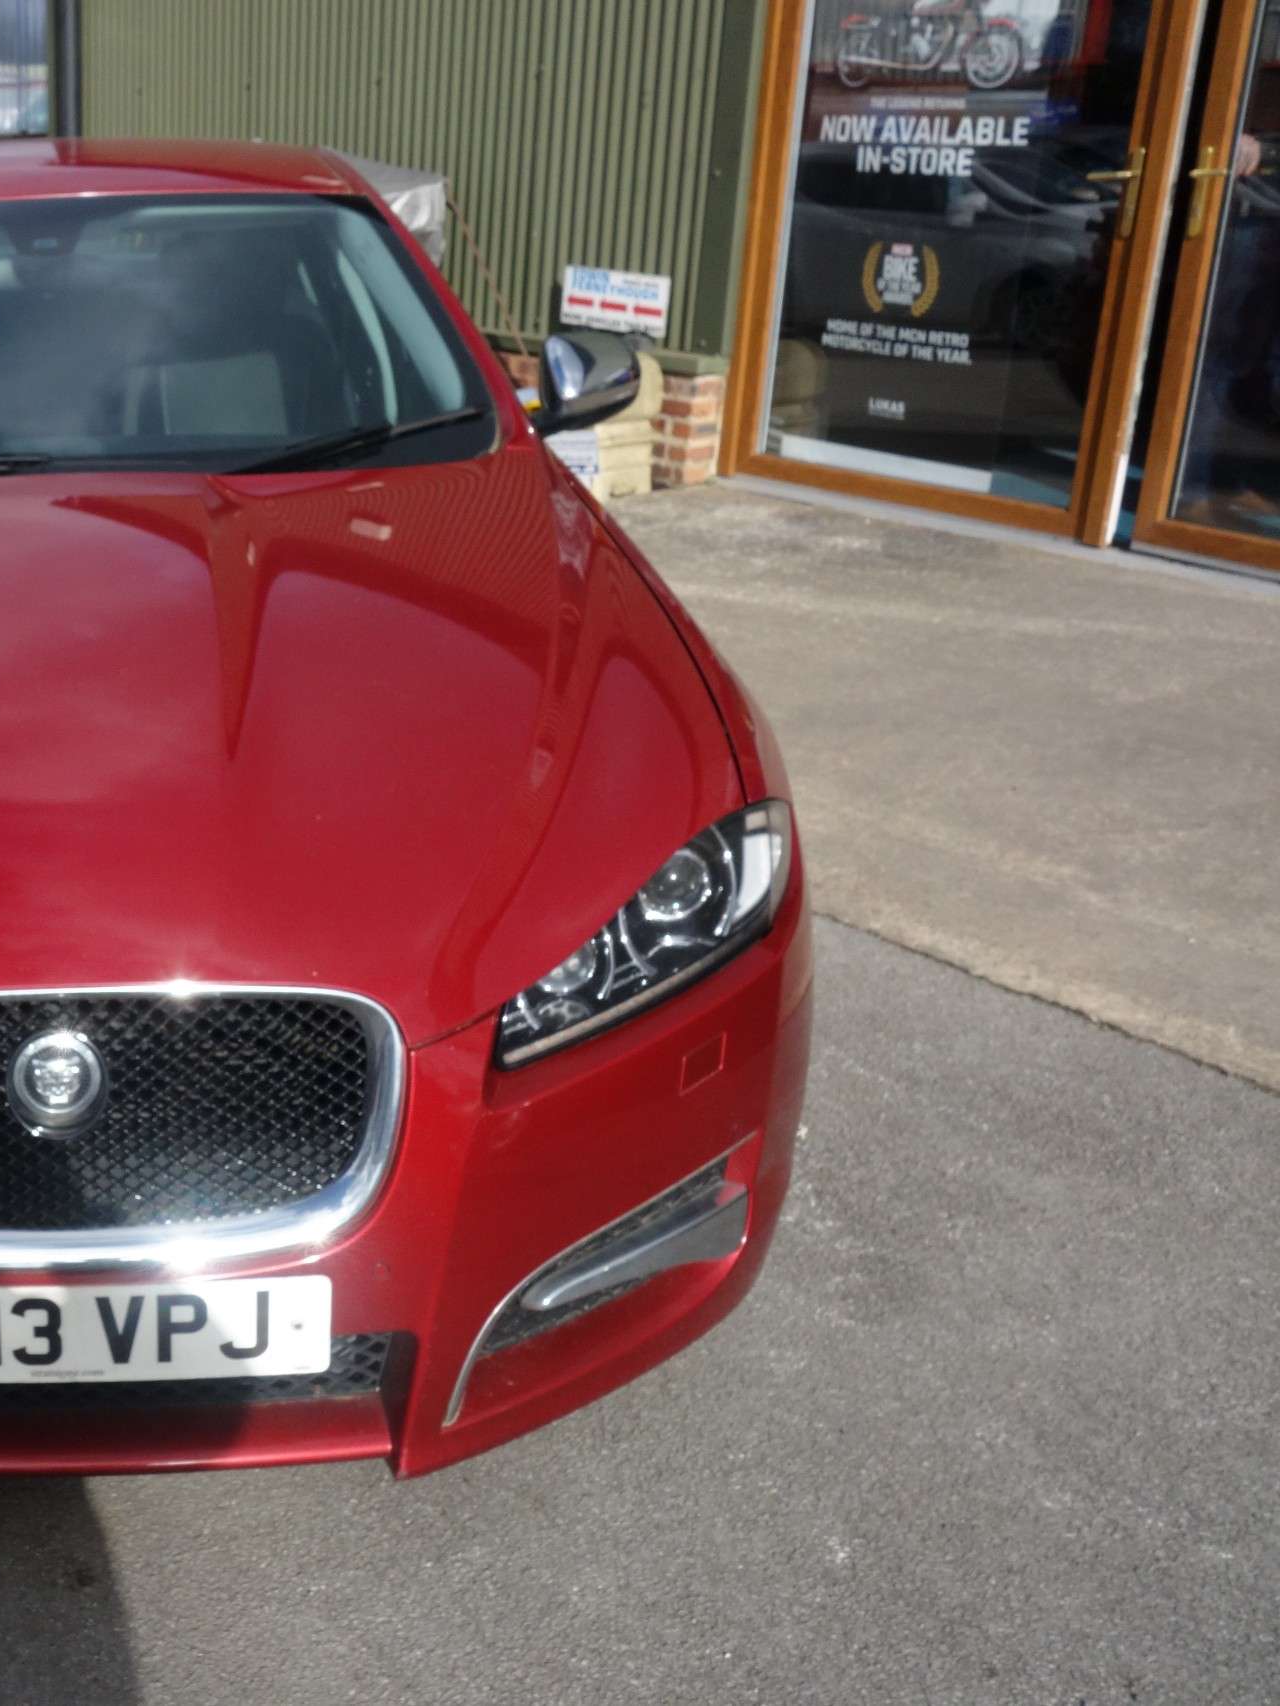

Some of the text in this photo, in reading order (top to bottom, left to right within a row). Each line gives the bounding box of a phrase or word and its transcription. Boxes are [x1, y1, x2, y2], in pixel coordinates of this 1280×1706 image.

[820, 114, 1030, 147] NOW AVAILABLE
[856, 145, 975, 177] IN-STORE
[883, 254, 919, 281] BIKE
[821, 332, 972, 366] MOTORCYCLE OF THE YEAR.
[826, 318, 970, 349] HOME OF THE MCN RETRO
[94, 1290, 270, 1363] VPJ
